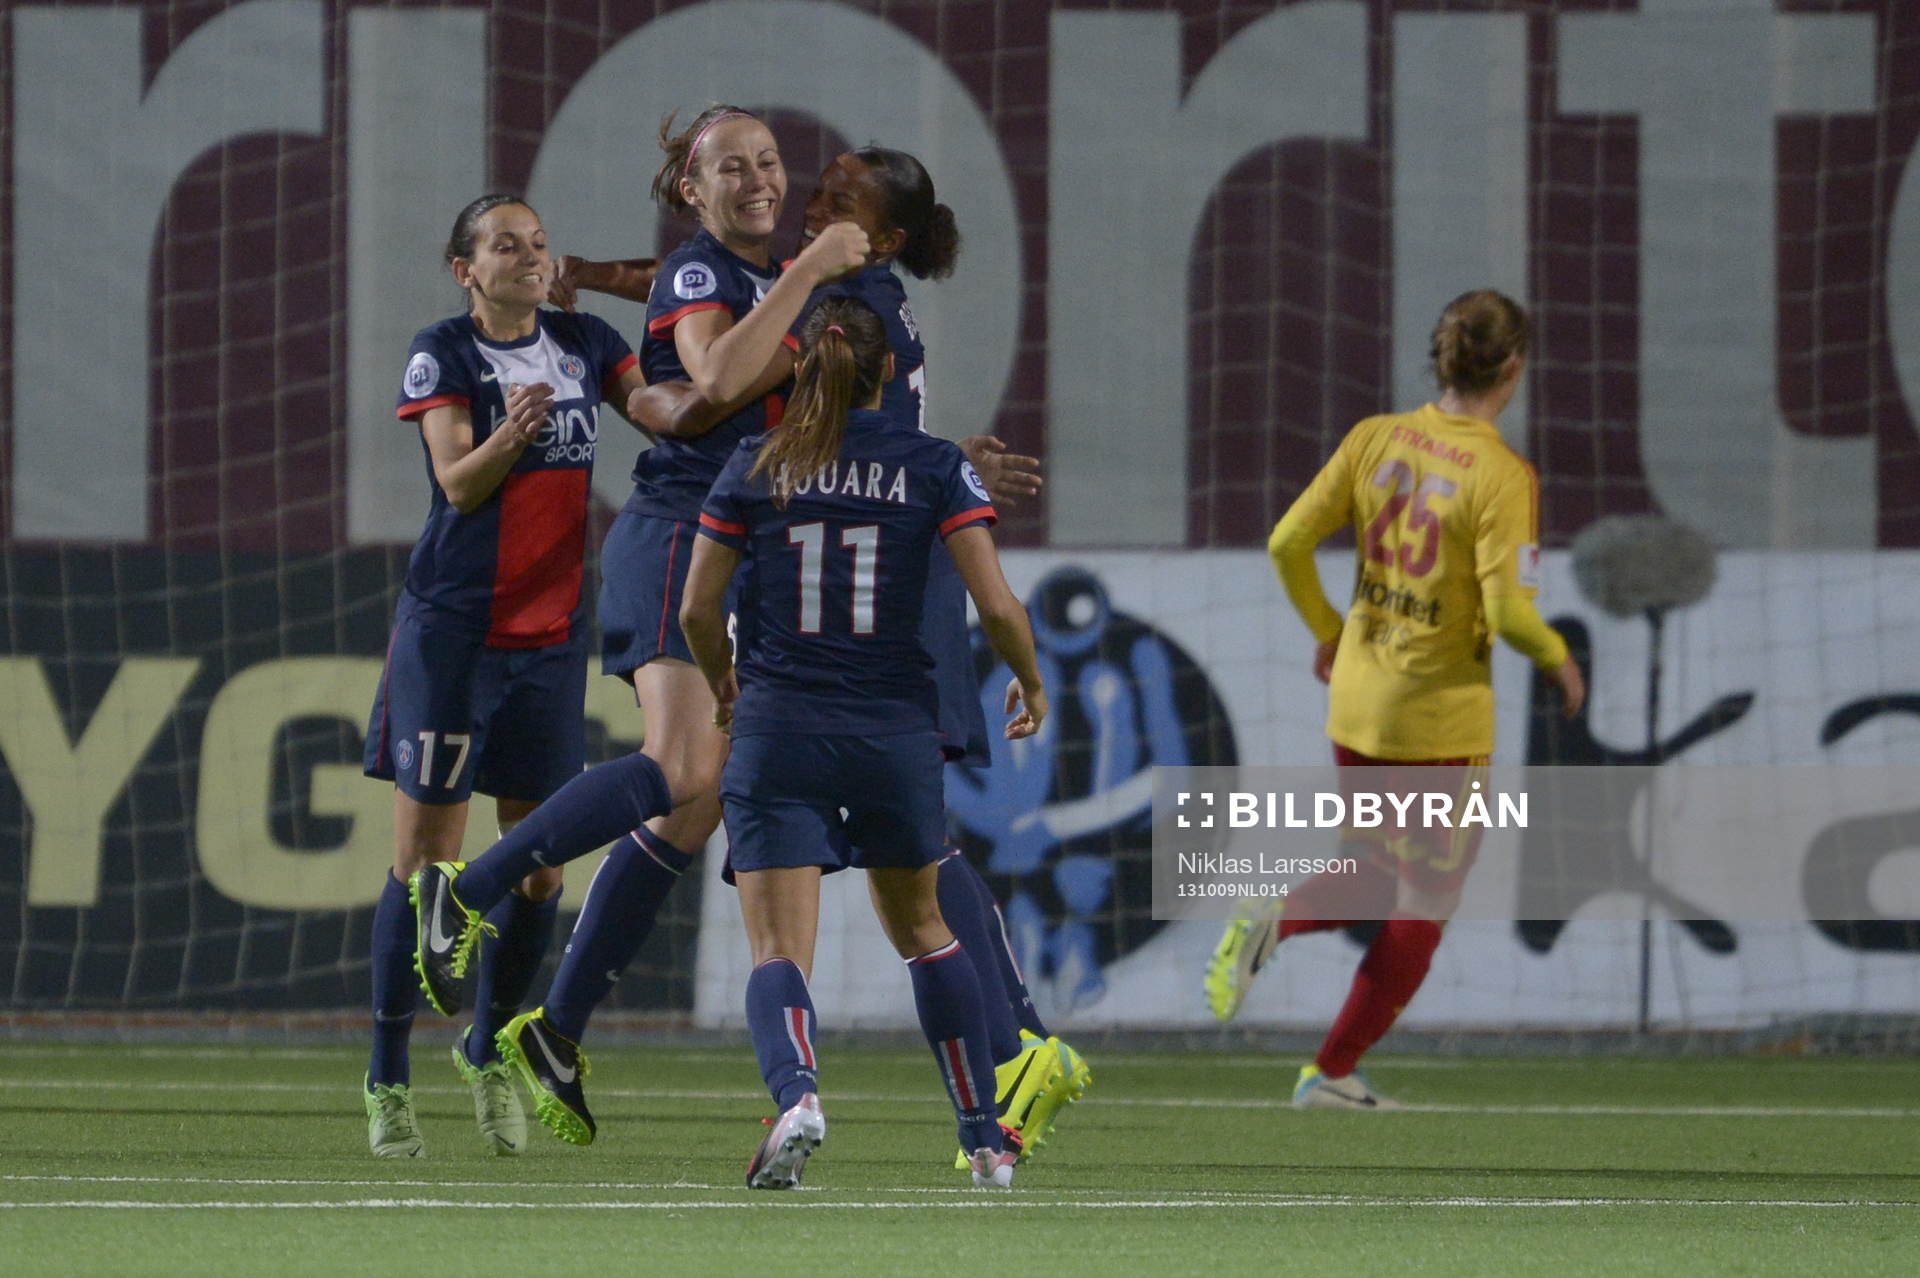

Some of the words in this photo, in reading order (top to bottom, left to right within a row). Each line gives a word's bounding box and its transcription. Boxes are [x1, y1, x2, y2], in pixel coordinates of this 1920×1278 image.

[12, 0, 1920, 547] riorit
[1365, 459, 1457, 578] 25
[788, 521, 879, 636] 11
[418, 731, 471, 789] 17
